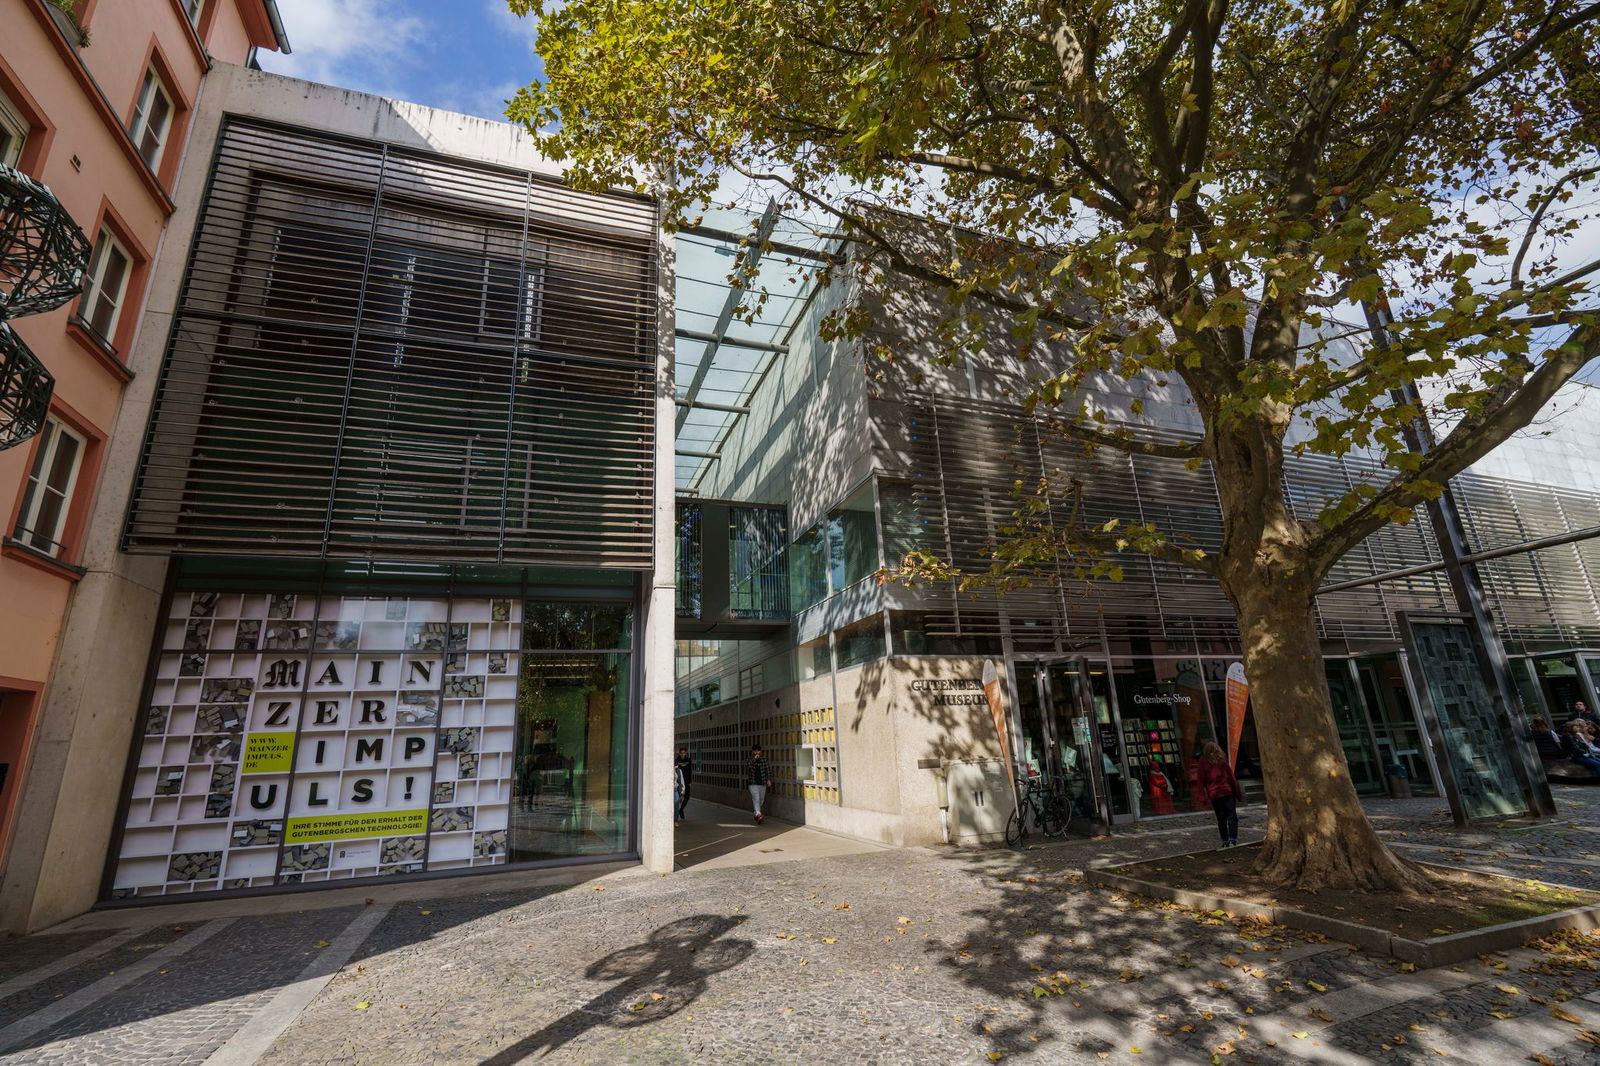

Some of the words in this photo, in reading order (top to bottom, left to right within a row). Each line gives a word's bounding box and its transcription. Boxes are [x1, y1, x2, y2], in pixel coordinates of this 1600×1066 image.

[263, 659, 435, 688] MAIN
[911, 679, 986, 691] GUTENBER
[1133, 693, 1191, 706] Gutenberg-Shop
[264, 700, 387, 727] ZER
[315, 737, 426, 764] IMP
[250, 777, 415, 809] ULS!
[291, 827, 366, 838] GUTENBERGSCHEN
[367, 822, 422, 832] TECHNOLOGIE!
[313, 821, 342, 829] STIMME
[344, 818, 359, 826] FÜR
[378, 816, 407, 824] ERHALT
